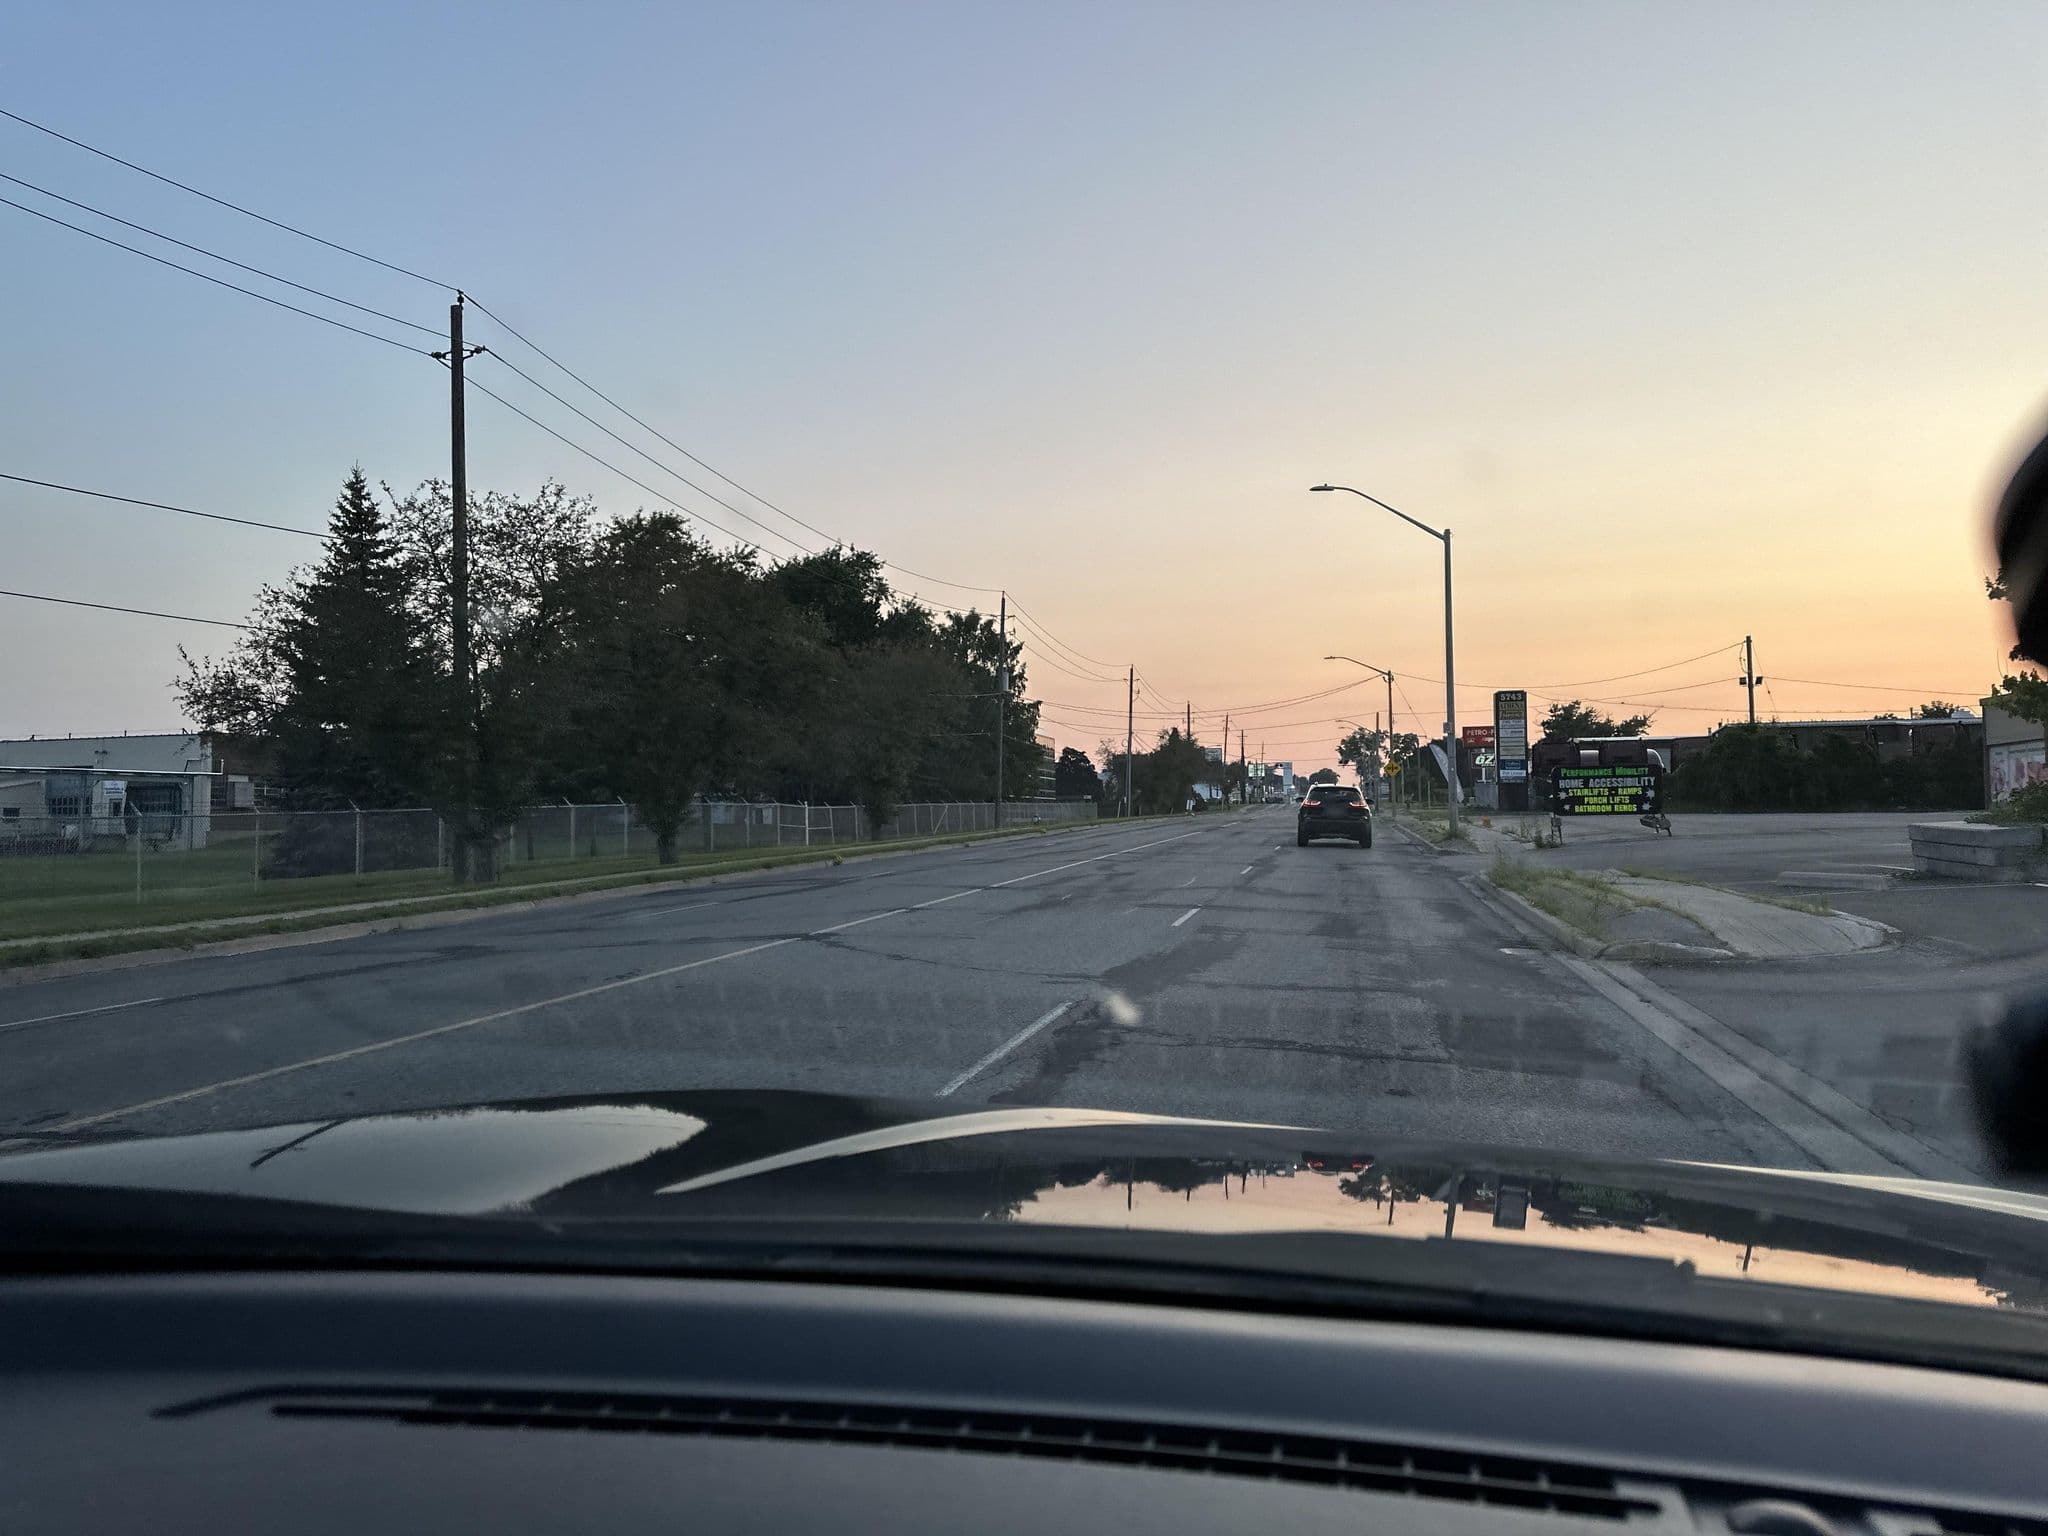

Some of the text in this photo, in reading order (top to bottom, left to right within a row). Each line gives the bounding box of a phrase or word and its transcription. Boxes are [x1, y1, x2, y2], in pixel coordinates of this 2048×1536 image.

[1561, 768, 1613, 777] PERFORMANCE
[1559, 777, 1655, 788] HOME ACCESSIBILITY
[1568, 788, 1609, 796] STAIRLIFTS
[1617, 787, 1643, 795] RAMPS
[1584, 796, 1630, 804] PORCH LIFTS
[1574, 804, 1612, 813] BATHROOM
